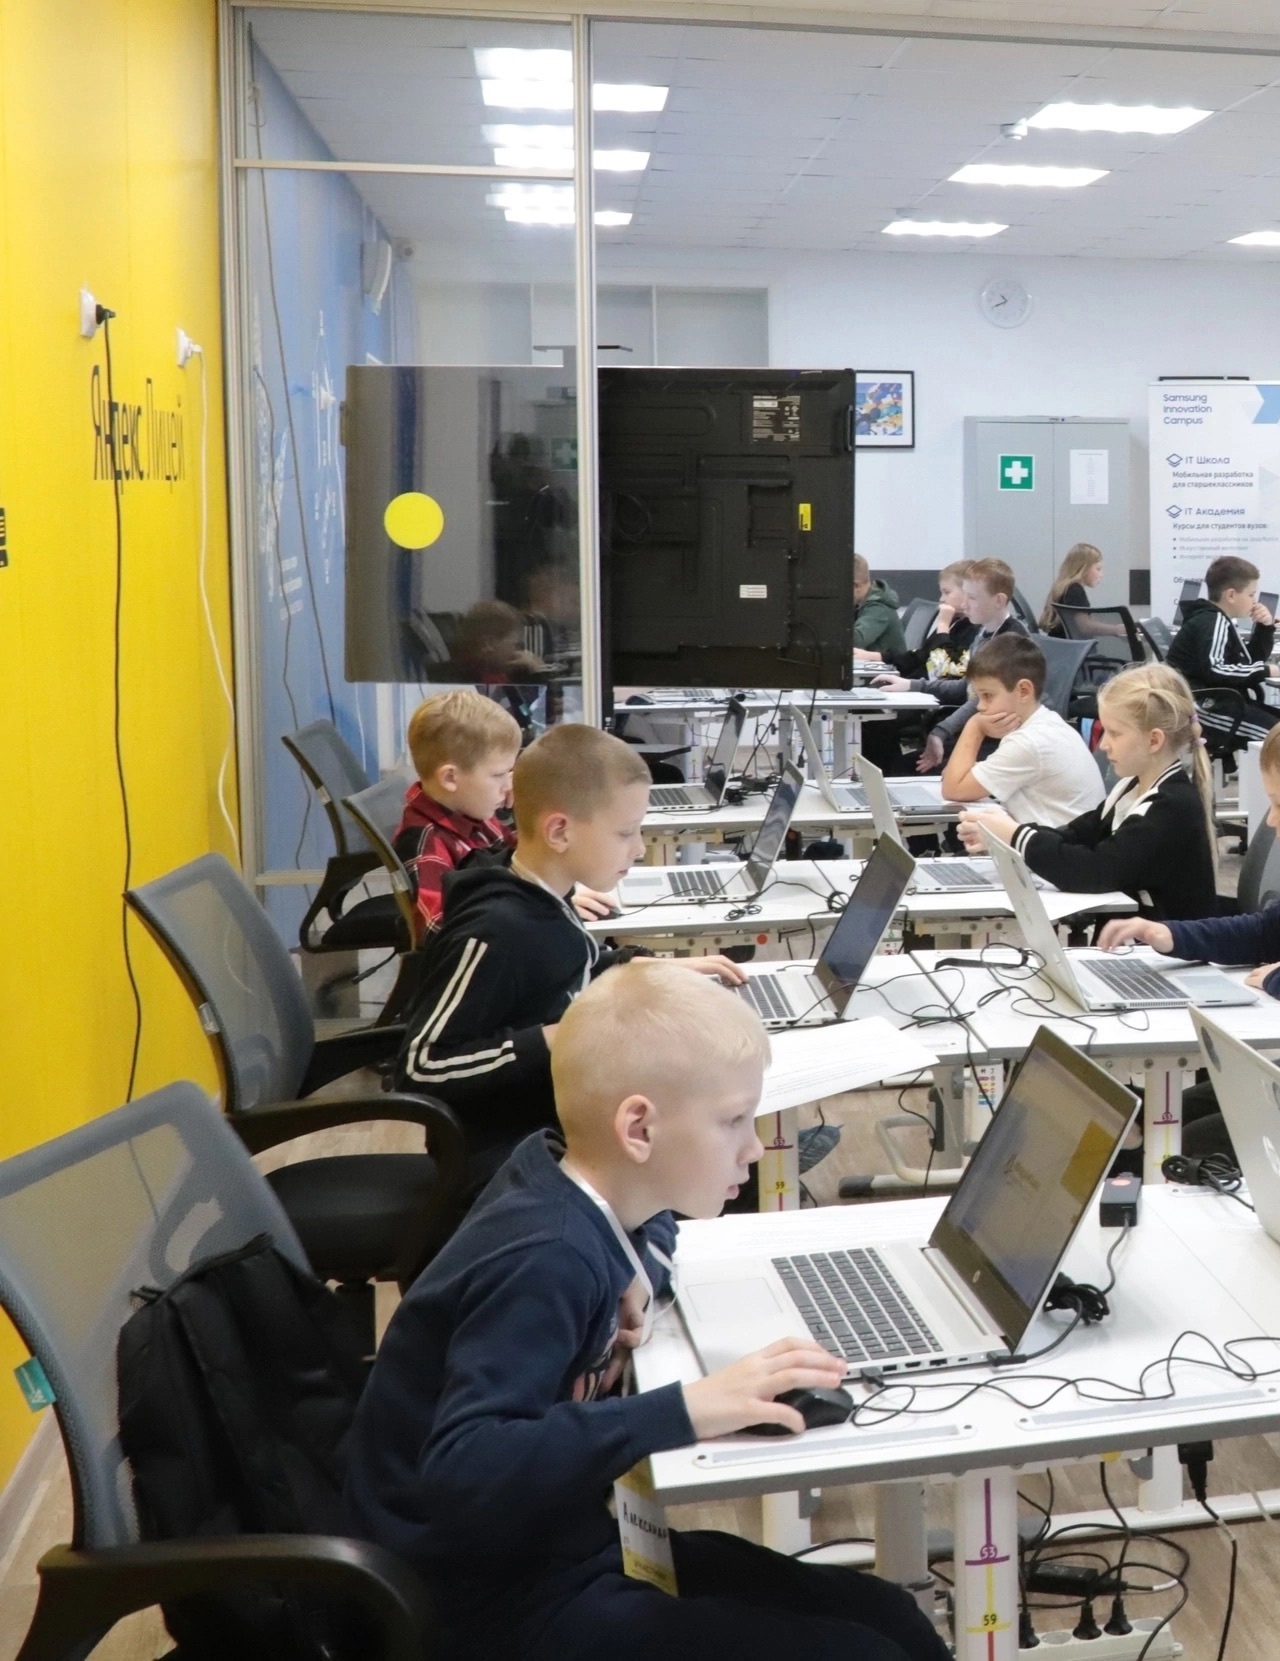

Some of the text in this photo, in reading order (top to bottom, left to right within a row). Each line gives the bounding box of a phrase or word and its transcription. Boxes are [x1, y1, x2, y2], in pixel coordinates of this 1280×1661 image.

[1163, 393, 1208, 404] Samsung
[1163, 405, 1212, 413] Innovation
[1163, 416, 1203, 426] Campus
[1196, 456, 1230, 465] Школа
[1213, 471, 1254, 479] разработка
[1172, 481, 1253, 489] для старшеклассников
[1196, 508, 1245, 517] Академия
[981, 1546, 996, 1558] 53
[983, 1614, 997, 1627] 59
